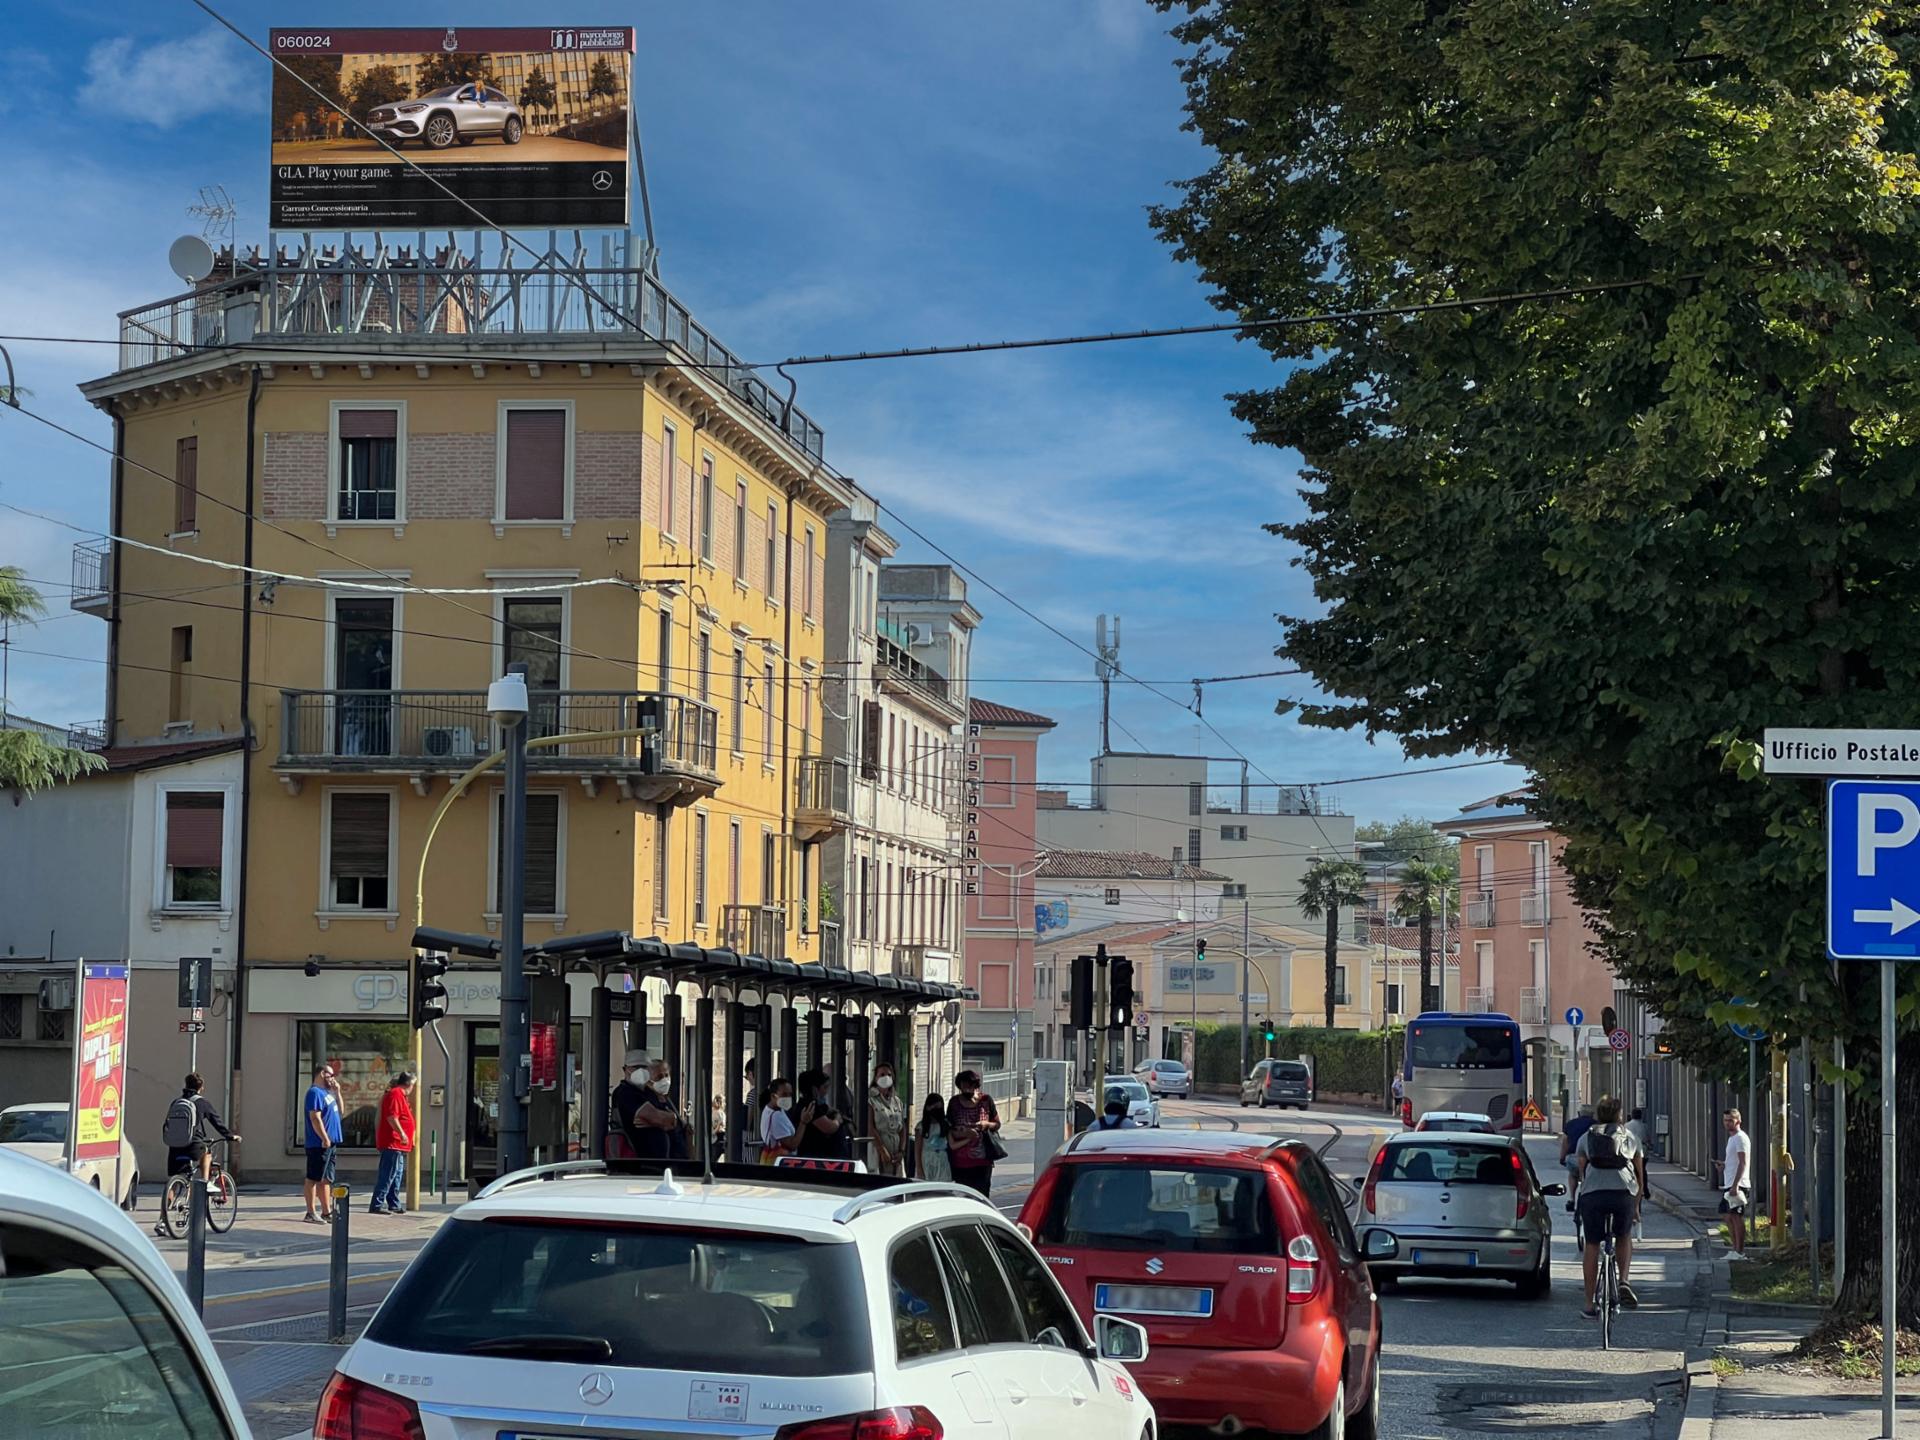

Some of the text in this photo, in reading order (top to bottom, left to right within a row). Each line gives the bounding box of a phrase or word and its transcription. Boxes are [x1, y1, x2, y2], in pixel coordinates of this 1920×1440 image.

[277, 36, 331, 48] 060024
[279, 166, 393, 180] GLA. Play your game.
[311, 204, 369, 212] Concessionaria
[1772, 741, 1919, 761] Ufficio Postale
[966, 726, 980, 893] RISORANTE
[1857, 793, 1920, 877] P
[1238, 1265, 1277, 1273] SPLASH
[718, 1394, 740, 1404] 143
